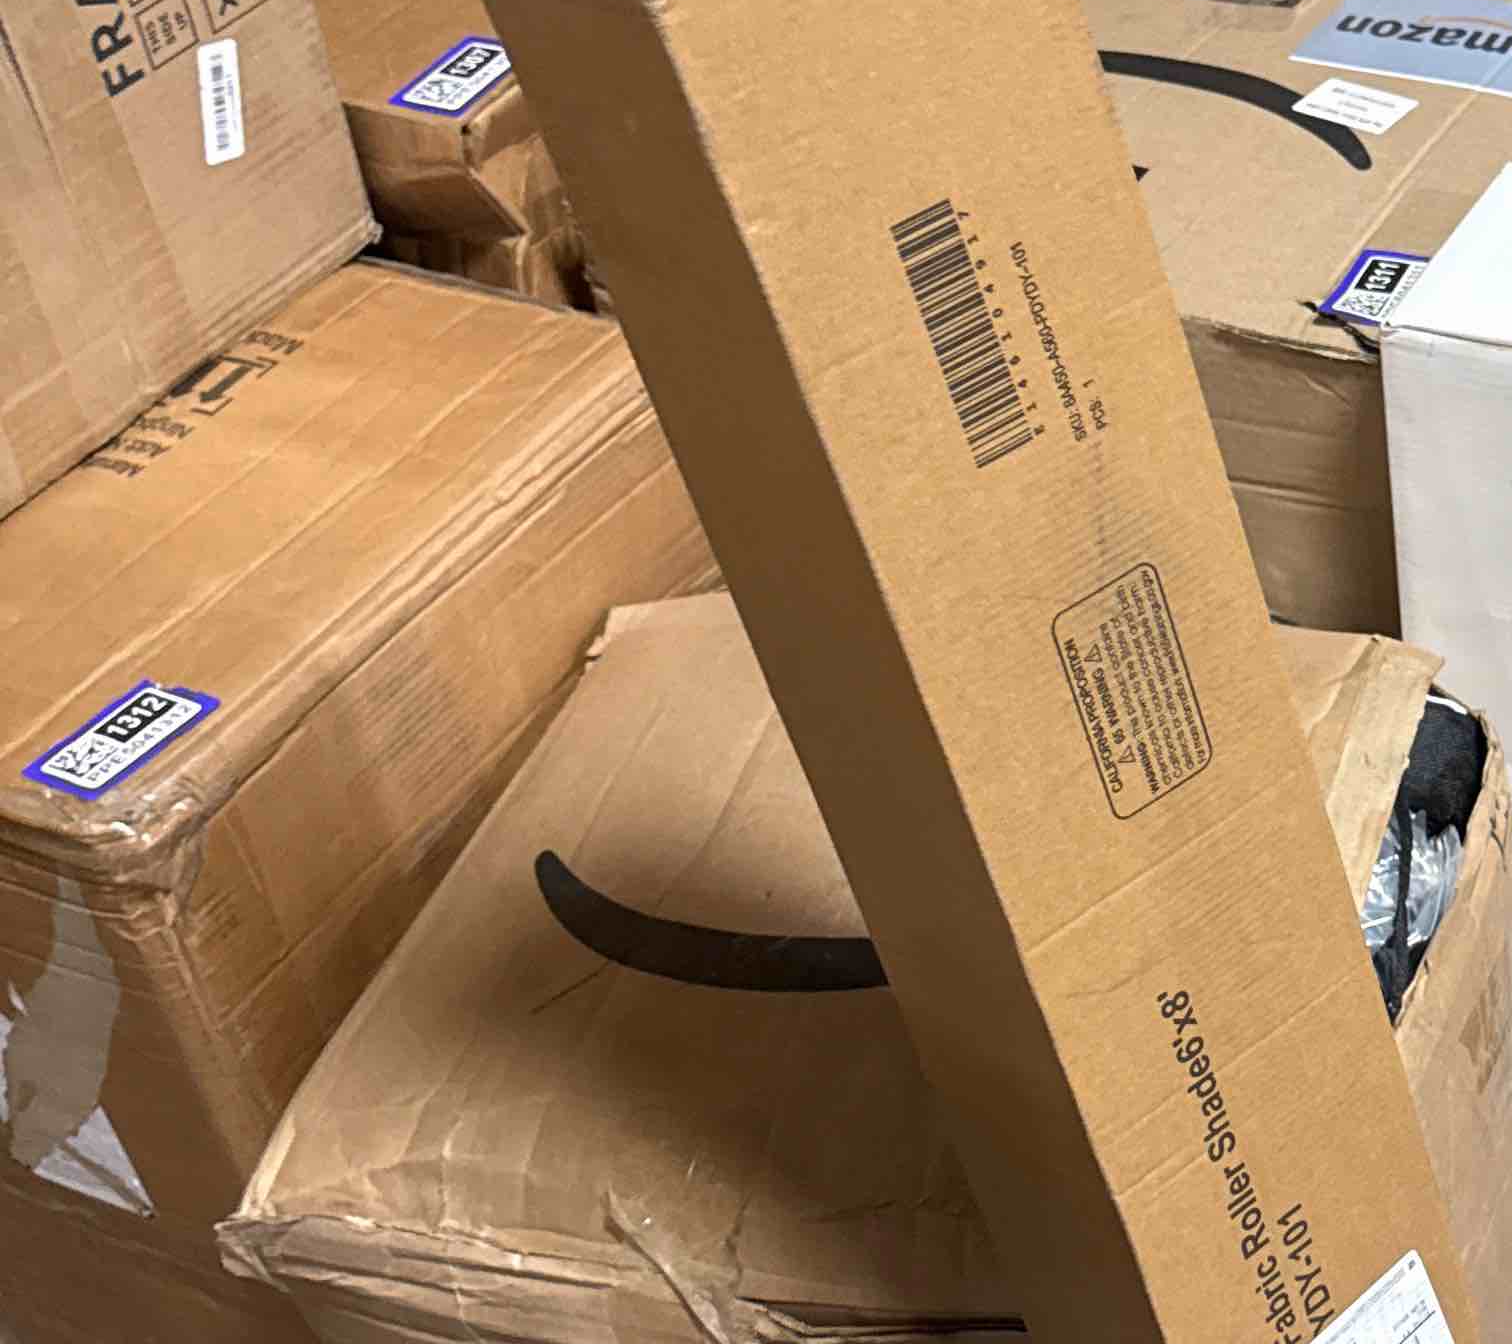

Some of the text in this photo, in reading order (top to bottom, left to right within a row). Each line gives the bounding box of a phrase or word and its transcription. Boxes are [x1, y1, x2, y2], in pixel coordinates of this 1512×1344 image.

[1363, 262, 1400, 288] 1311
[105, 694, 167, 736] 1312
[1062, 637, 1123, 794] CALIFORNIA PROPOSITION
[1091, 667, 1119, 728] WARNING
[1220, 1161, 1269, 1260] Roller
[1277, 1202, 1336, 1336] YDY-101
